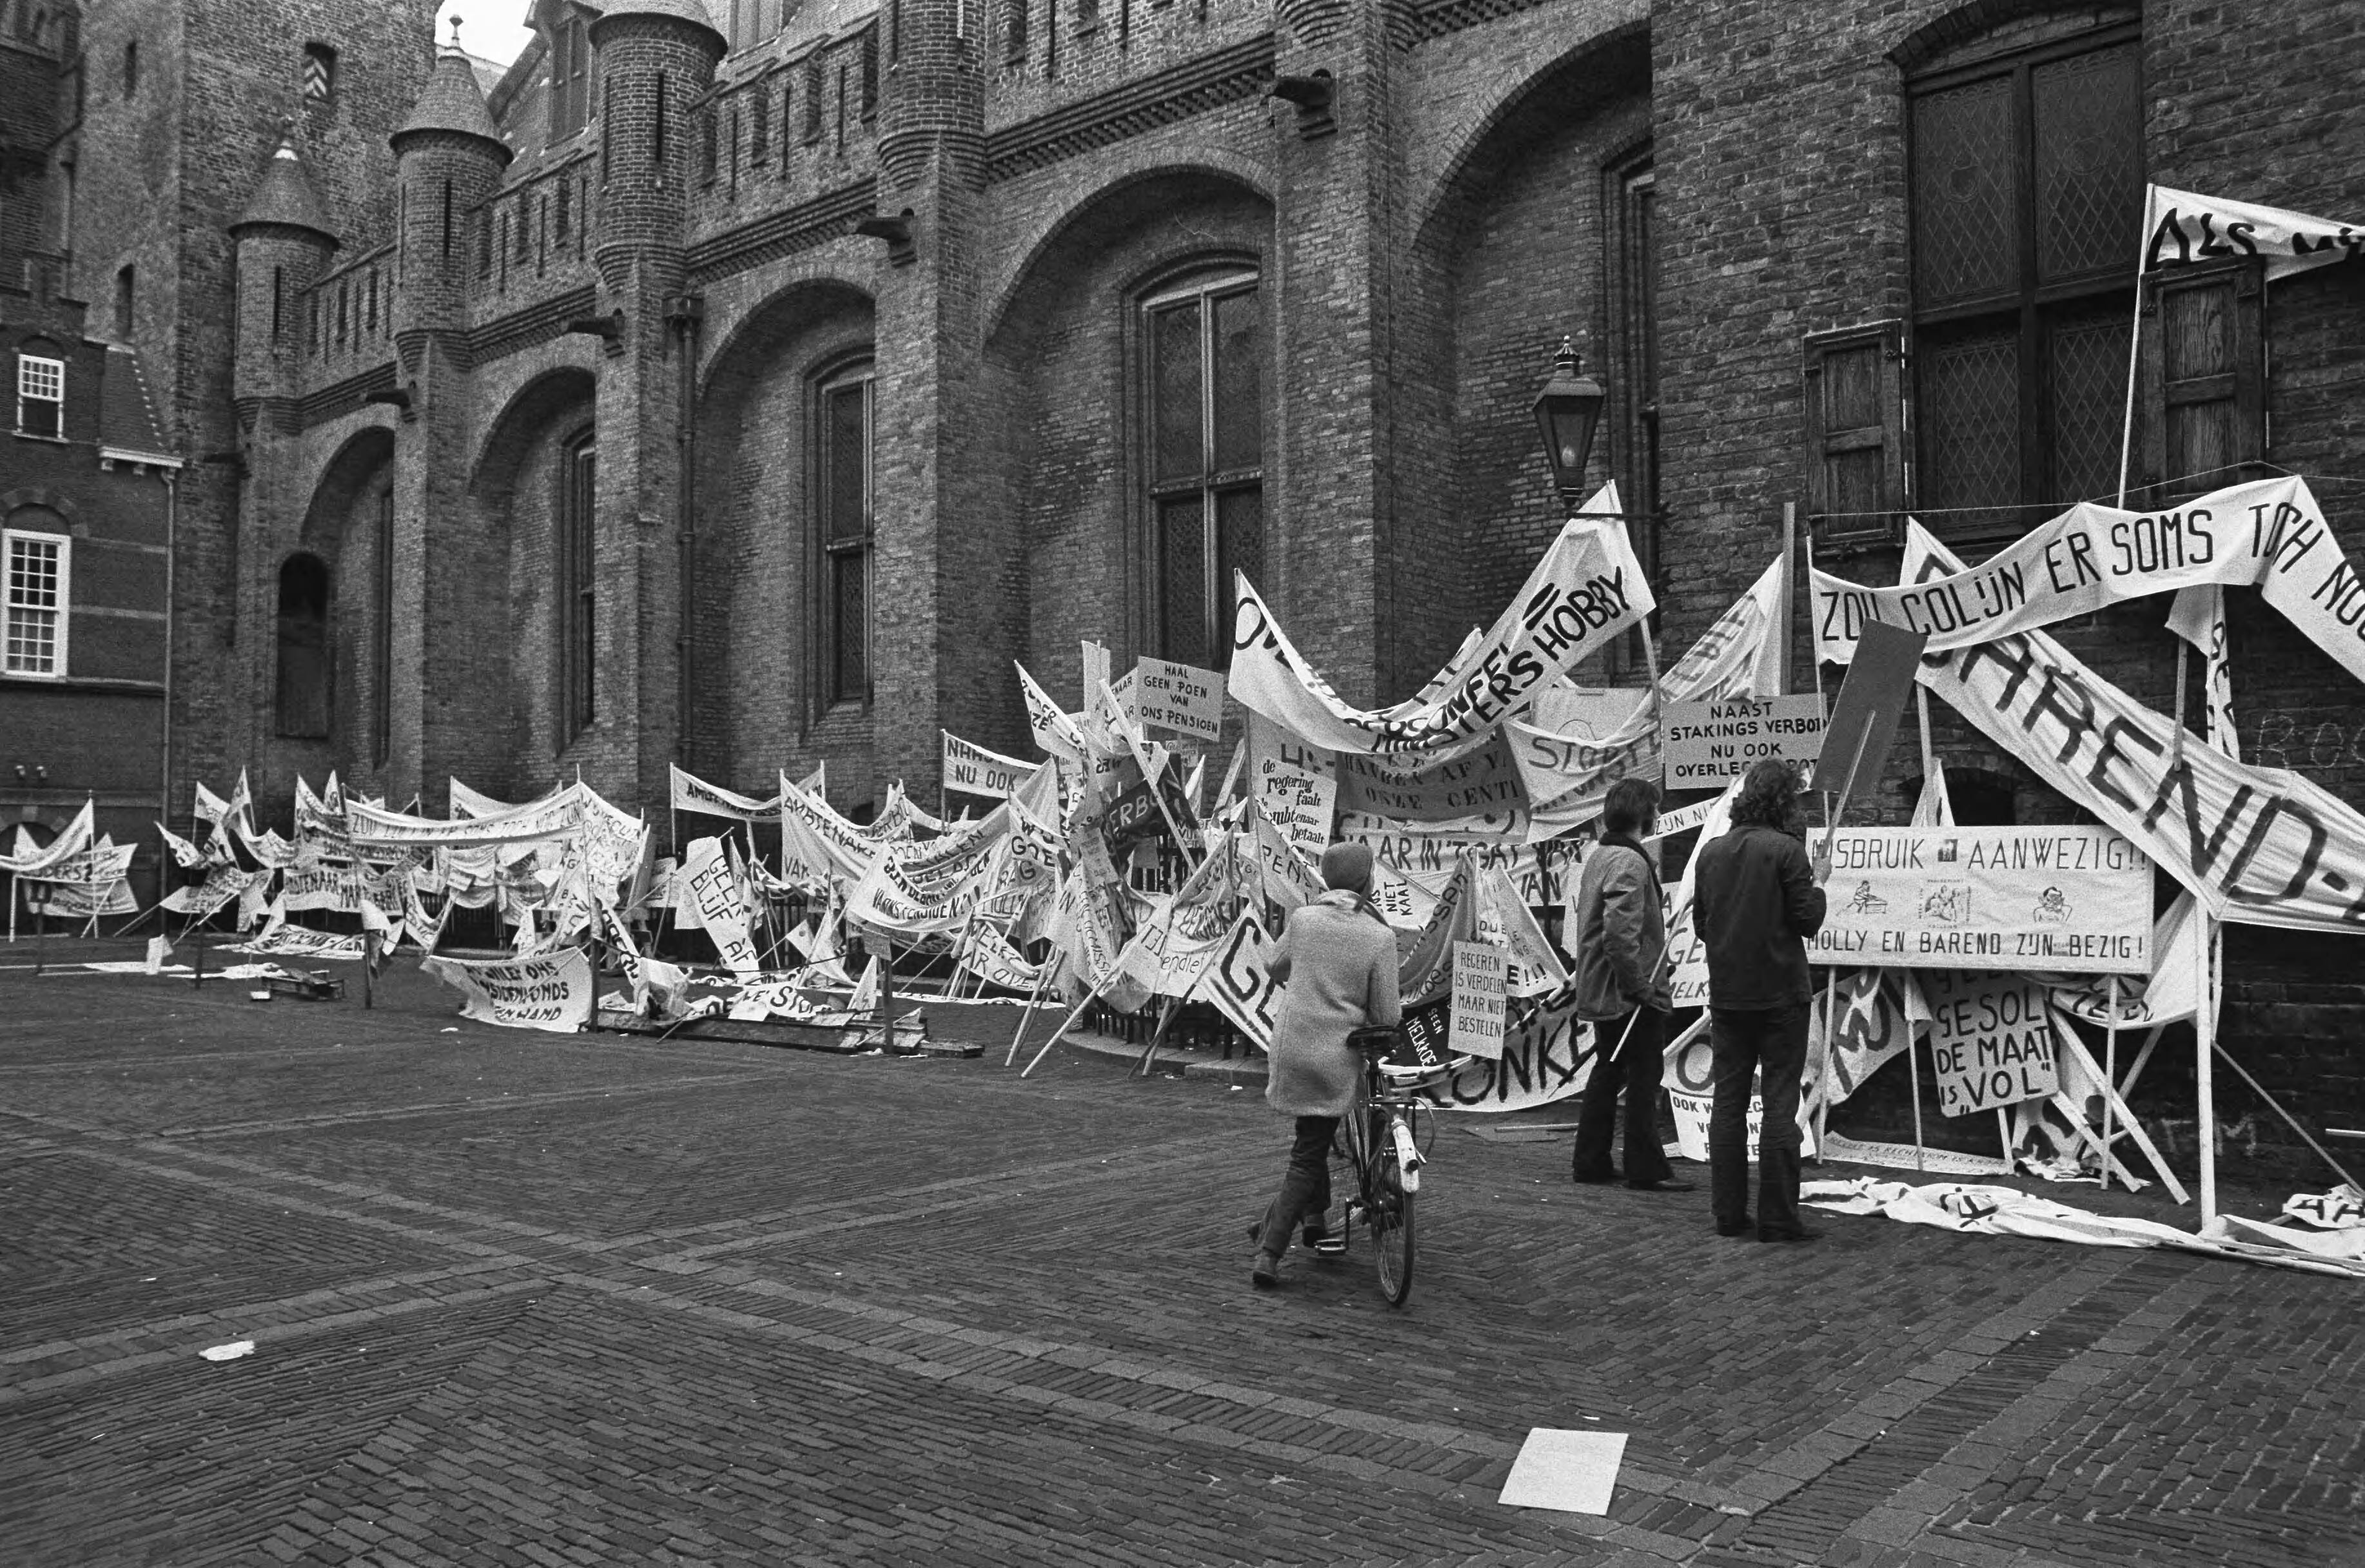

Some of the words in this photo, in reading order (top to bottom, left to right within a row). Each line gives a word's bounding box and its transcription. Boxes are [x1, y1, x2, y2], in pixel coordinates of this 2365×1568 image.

[2045, 533, 2102, 593] ER
[2112, 509, 2213, 576] SOMS
[1532, 565, 1630, 662] HOBBY
[1164, 665, 1189, 678] HAAL
[1144, 676, 1170, 689] GEEN
[1177, 681, 1208, 698] POEN
[1170, 694, 1189, 707] VAN
[1711, 701, 1772, 720] NAAST
[1141, 706, 1163, 720] ONS
[1167, 710, 1219, 734] PENSIOEN
[1670, 721, 1758, 741] STAKINGS
[1711, 744, 1734, 758] NU
[1743, 743, 1782, 757] OOK
[956, 764, 977, 784] NU
[986, 770, 1017, 792] OOK
[1262, 759, 1276, 774] de
[1266, 772, 1315, 796] regering
[1295, 789, 1321, 807] faalt
[1290, 823, 1325, 845] betaalt
[1384, 881, 1398, 912] NIET
[1396, 879, 1413, 916] KAAL
[1881, 930, 1905, 952] EN
[1919, 932, 2000, 955] BAREND
[1460, 952, 1501, 973] REGEREN
[1455, 971, 1464, 988] IS
[1466, 972, 1507, 995] VERDELEN
[1669, 980, 1710, 999] ELK
[1458, 993, 1485, 1014] MAAR
[1487, 999, 1505, 1016] NIET
[1936, 986, 2043, 1038] GESOL
[1427, 1006, 1444, 1035] GEEN
[1457, 1015, 1502, 1038] BESTELEN
[1936, 1042, 1967, 1075] DE
[1977, 1025, 2050, 1069] MAAT
[1673, 1097, 1699, 1113] OOK
